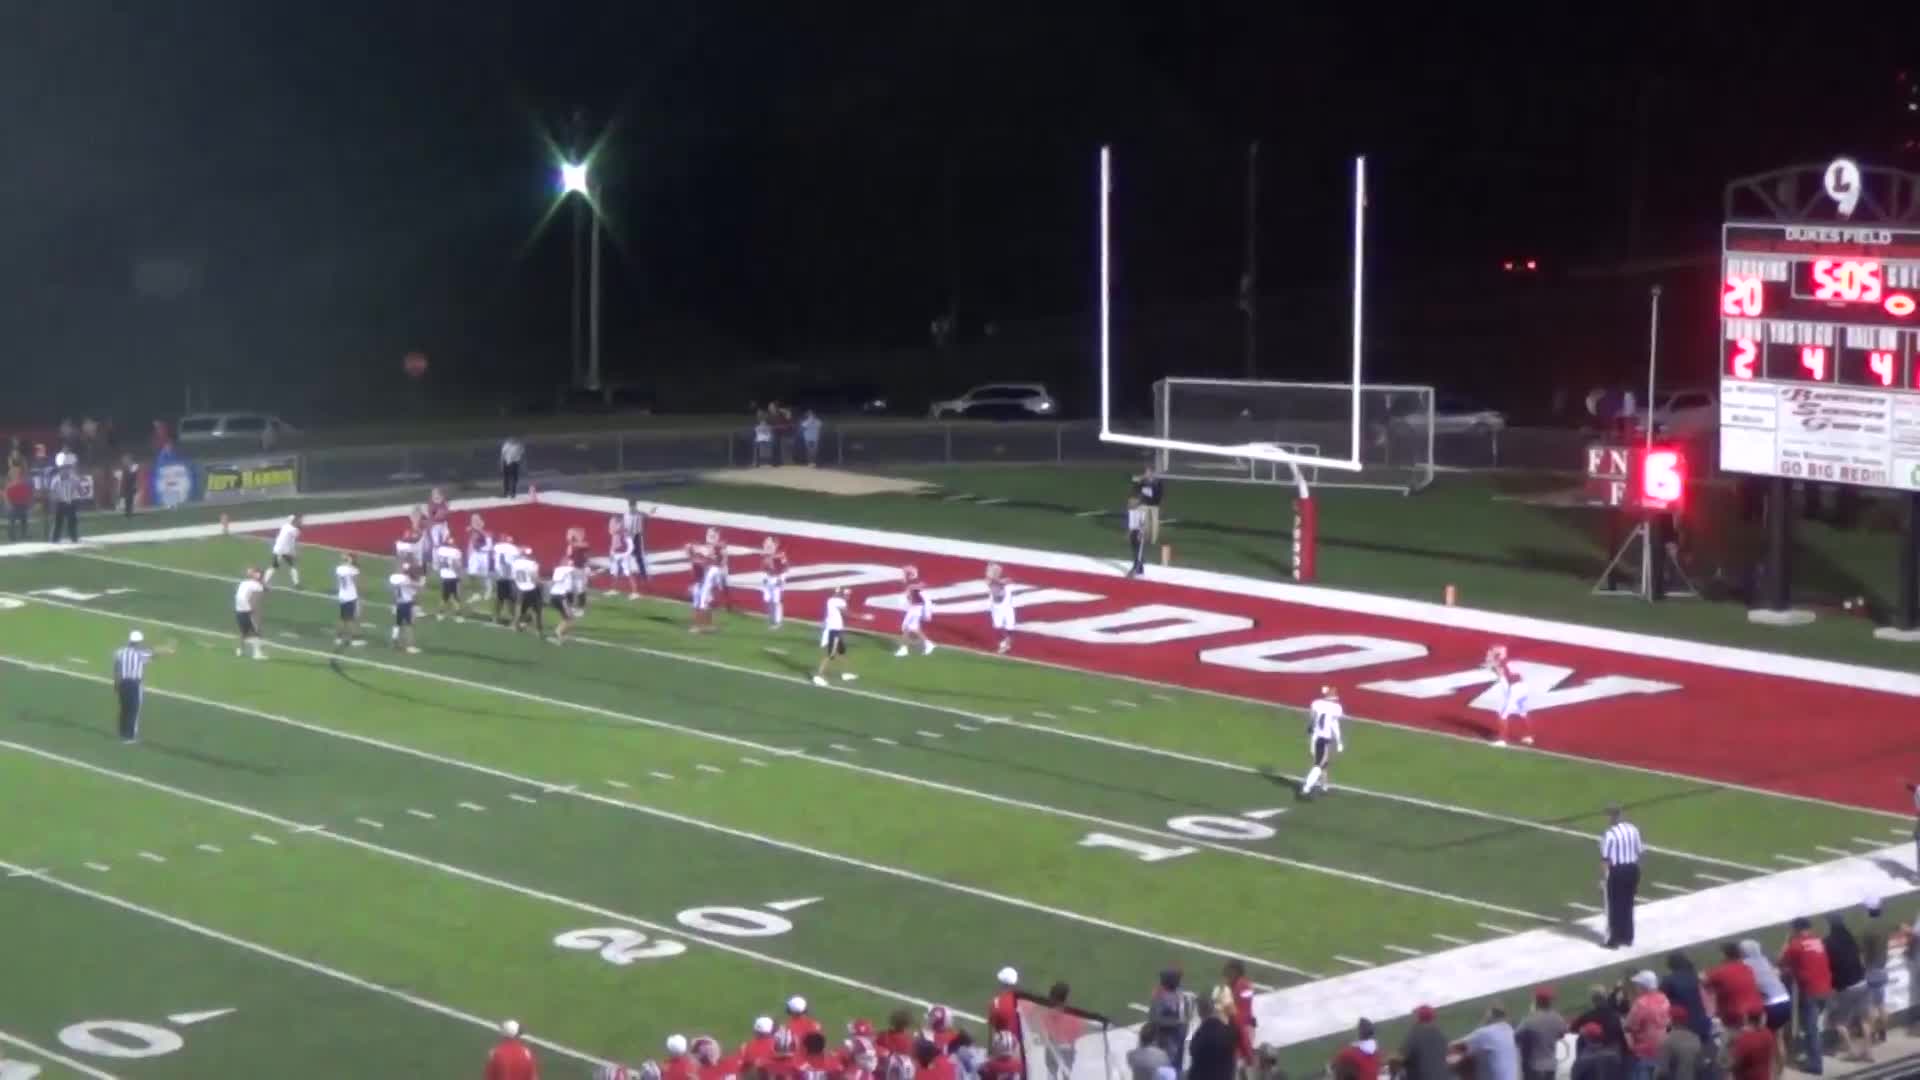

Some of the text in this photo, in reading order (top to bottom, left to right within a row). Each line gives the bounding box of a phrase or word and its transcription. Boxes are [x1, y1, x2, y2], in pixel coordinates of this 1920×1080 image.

[1723, 276, 1763, 317] 20
[1813, 259, 1880, 301] 5:05
[1732, 338, 1757, 379] 2
[1801, 347, 1825, 381] 4
[1870, 352, 1894, 386] 4
[1781, 460, 1802, 475] GO
[1808, 463, 1833, 479] BIG
[554, 905, 793, 965] 20
